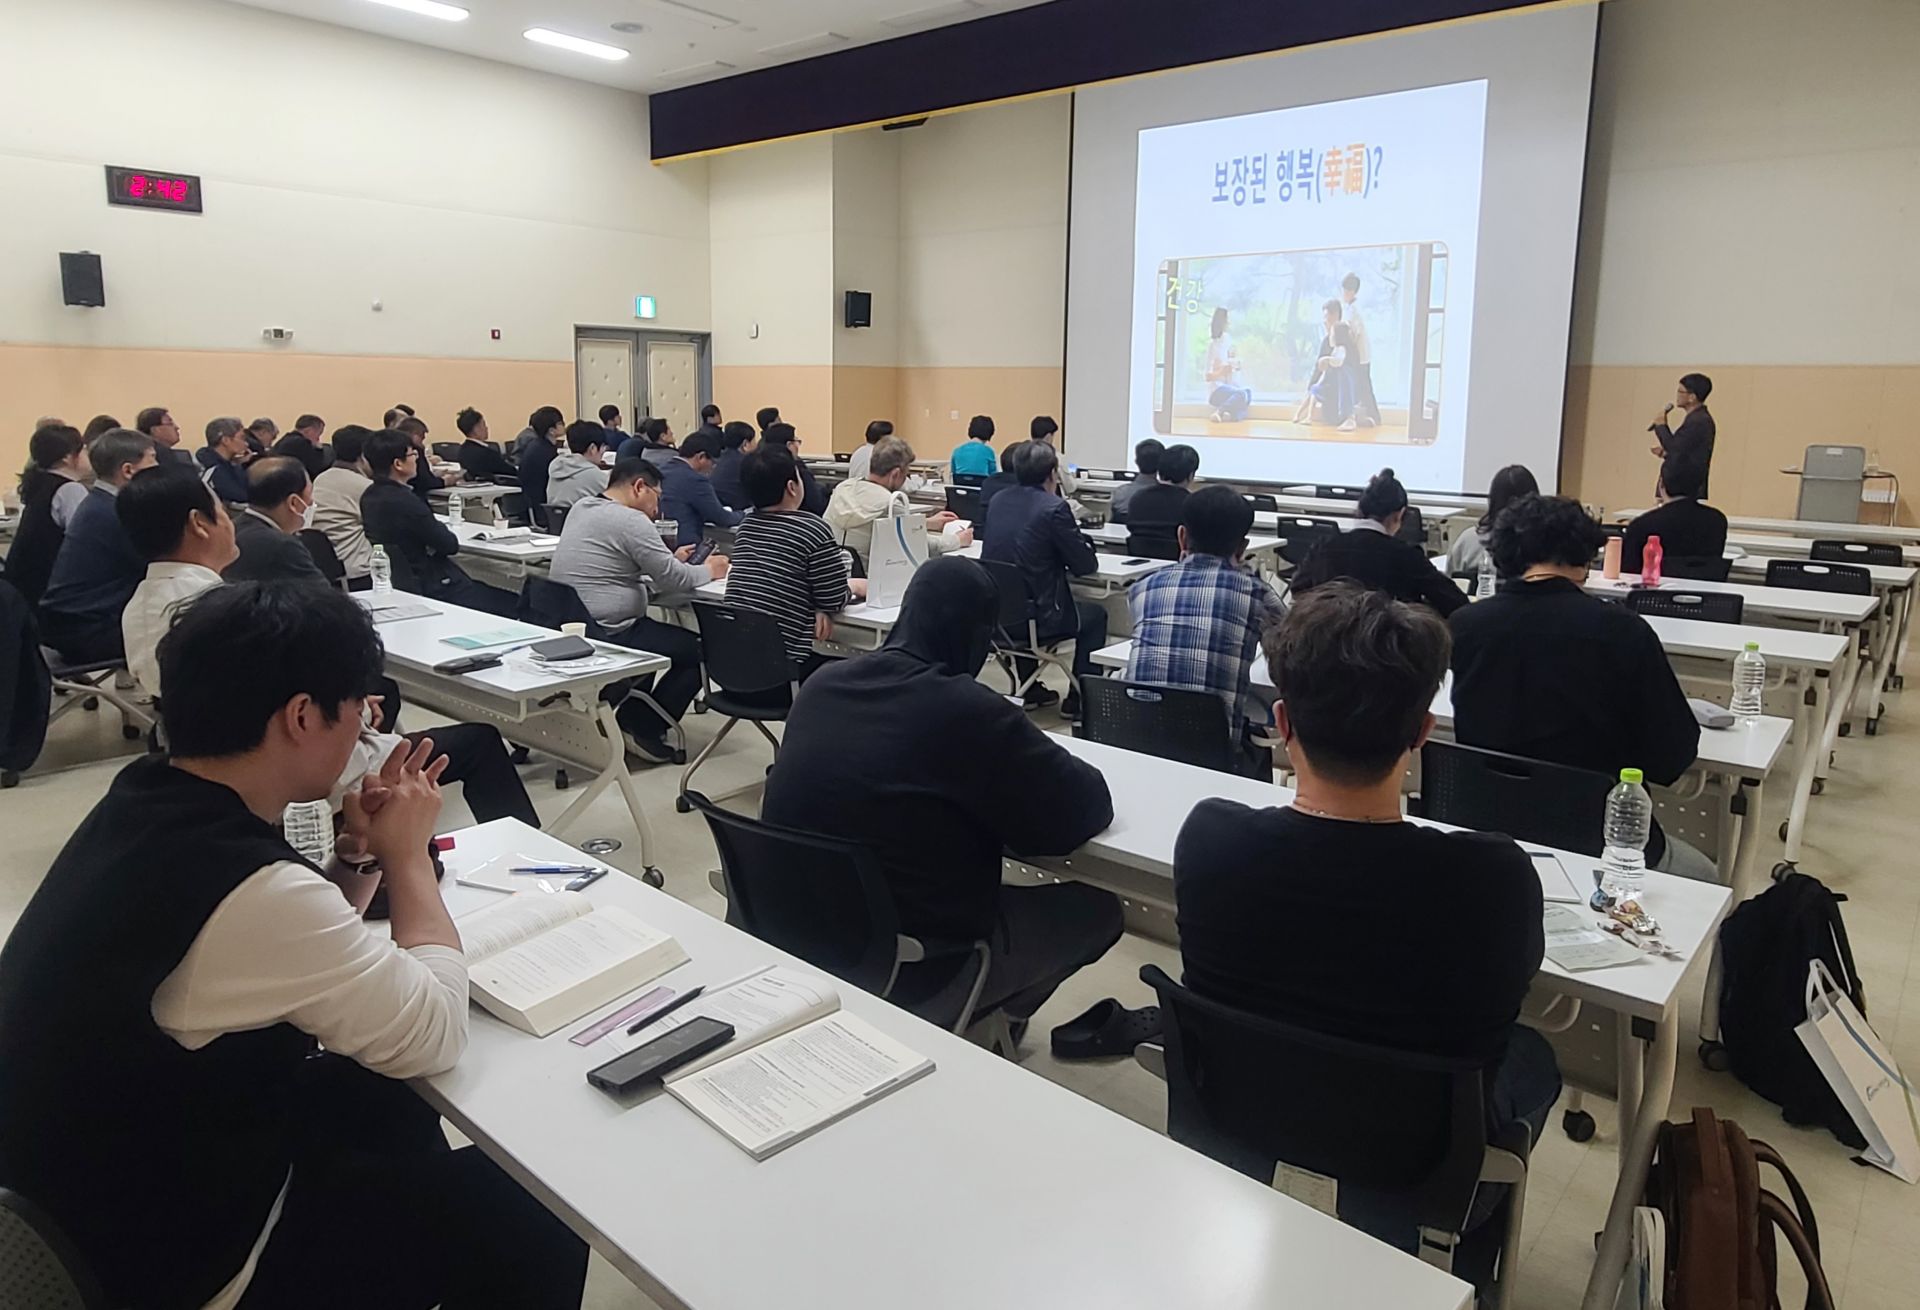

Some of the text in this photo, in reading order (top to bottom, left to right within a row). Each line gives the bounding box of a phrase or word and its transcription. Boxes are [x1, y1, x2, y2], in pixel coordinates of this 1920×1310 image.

[129, 174, 188, 203] 2:42
[1211, 143, 1383, 207] 보장된 행복(幸福)?
[1166, 276, 1203, 314] 건강
